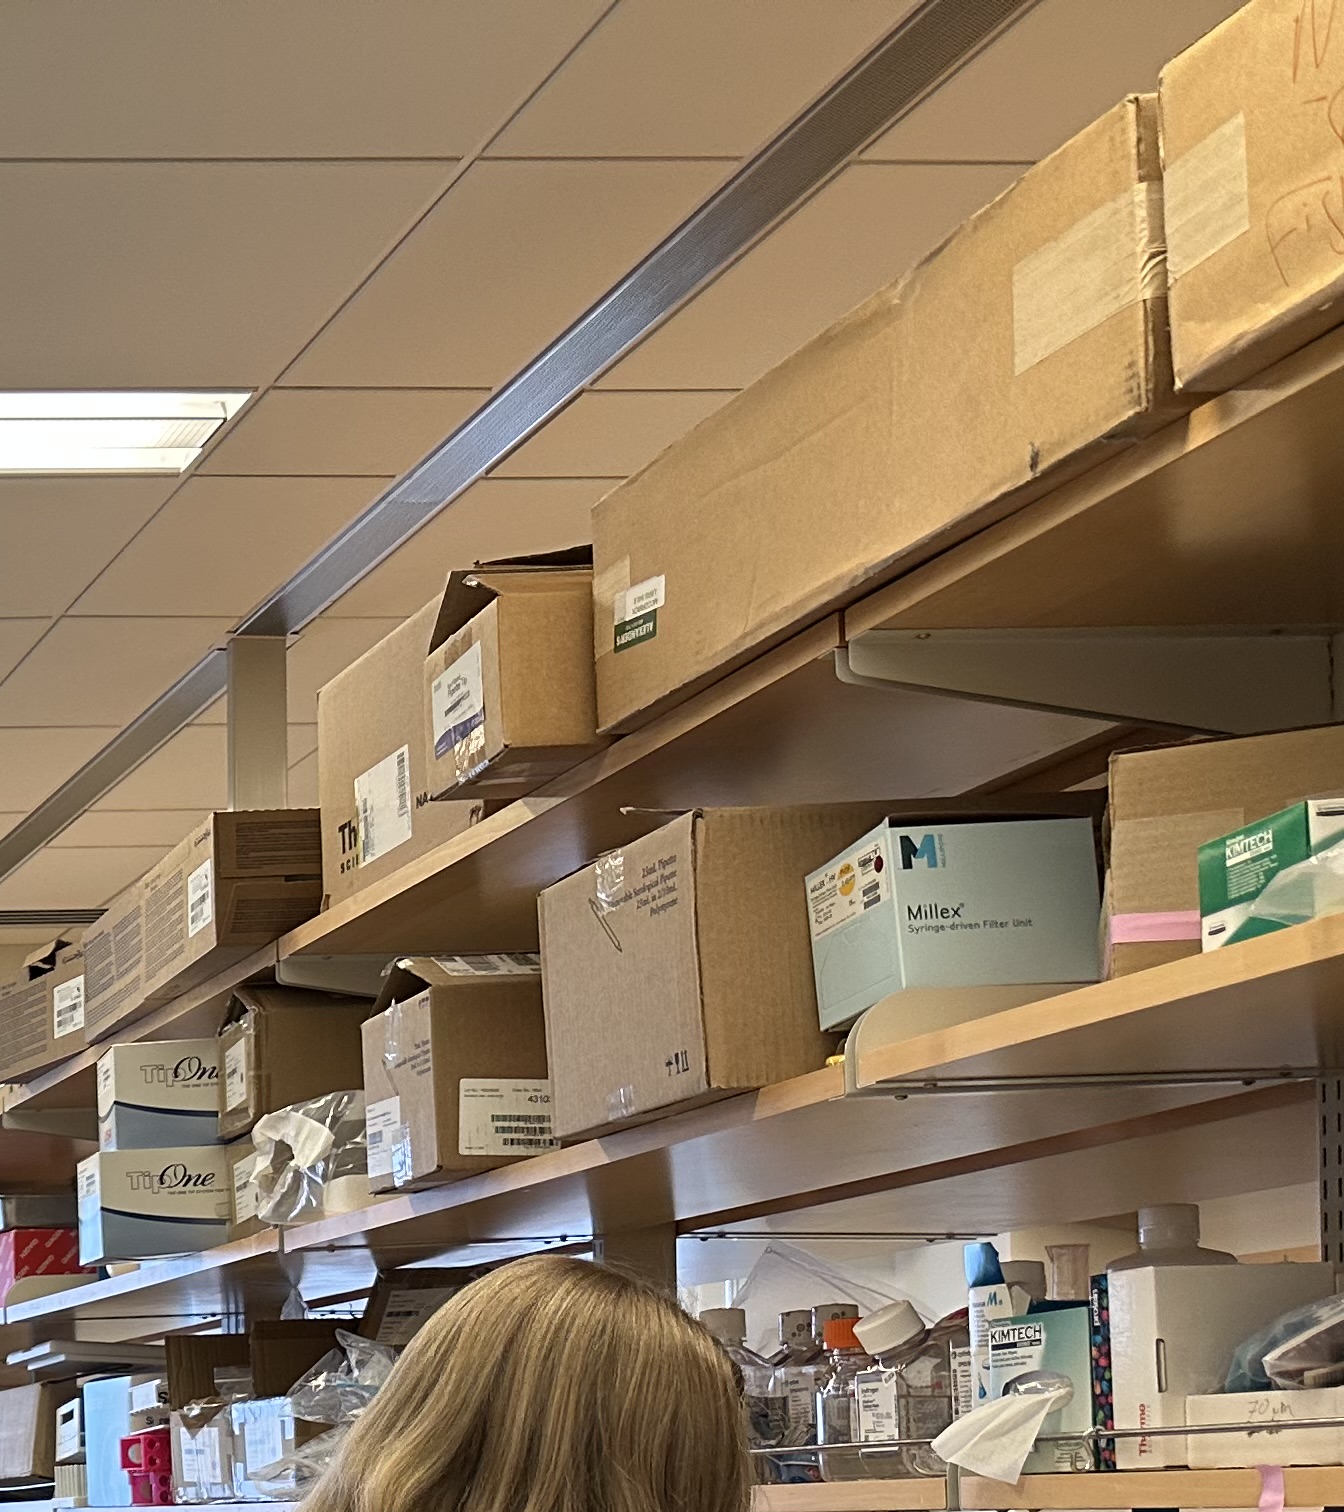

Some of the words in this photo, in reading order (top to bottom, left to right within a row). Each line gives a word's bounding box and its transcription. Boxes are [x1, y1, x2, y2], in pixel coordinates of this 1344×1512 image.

[1226, 829, 1273, 859] KIMTECH
[908, 921, 981, 934] Syringe-driven
[983, 919, 1009, 929] Filter
[1012, 918, 1033, 928] Unit
[126, 1163, 216, 1194] TipOne
[990, 1324, 1042, 1343] KIMTECH
